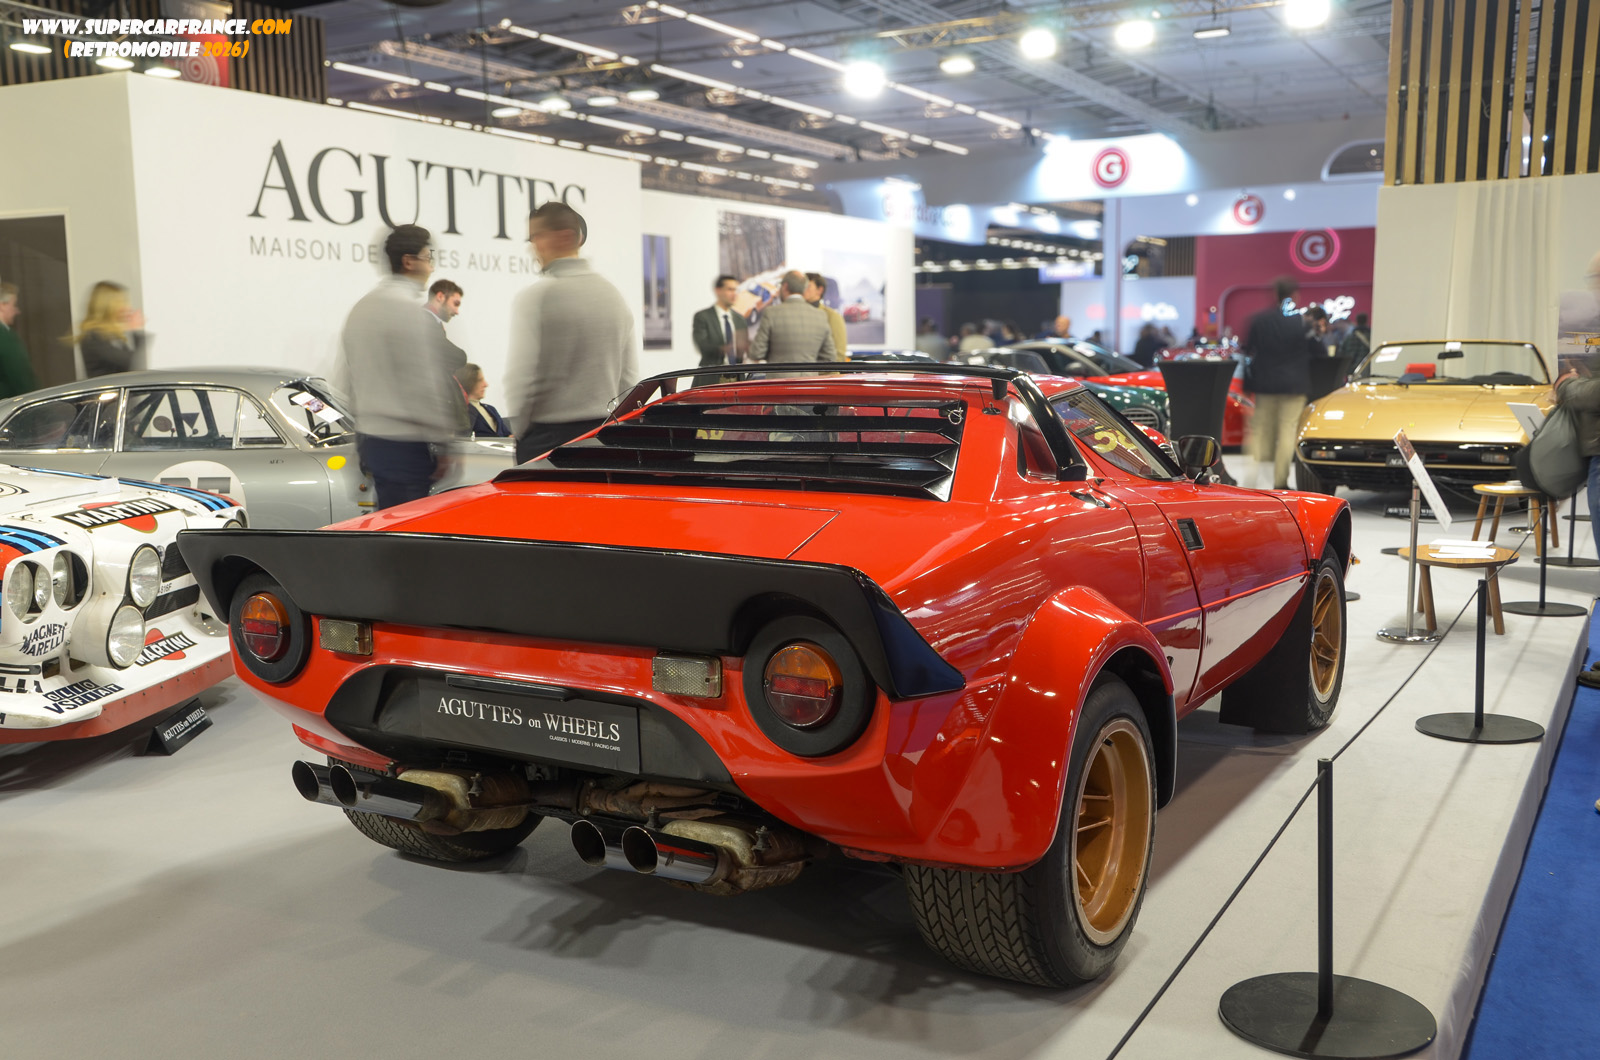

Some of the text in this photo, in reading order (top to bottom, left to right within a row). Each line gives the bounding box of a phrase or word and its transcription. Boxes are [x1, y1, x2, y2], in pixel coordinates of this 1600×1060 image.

[249, 236, 342, 262] MAISON
[467, 252, 502, 273] AUX
[64, 499, 171, 526] MARTINI
[19, 634, 65, 657] MARELLI
[136, 634, 194, 665] MARTINI
[44, 680, 99, 701] OLIO
[163, 721, 185, 741] AGUTTES
[186, 707, 206, 723] WHEELS
[437, 697, 620, 742] AGUTTES on WHEELS
[549, 735, 567, 743] CLASSICS
[572, 739, 590, 747] MODERNS
